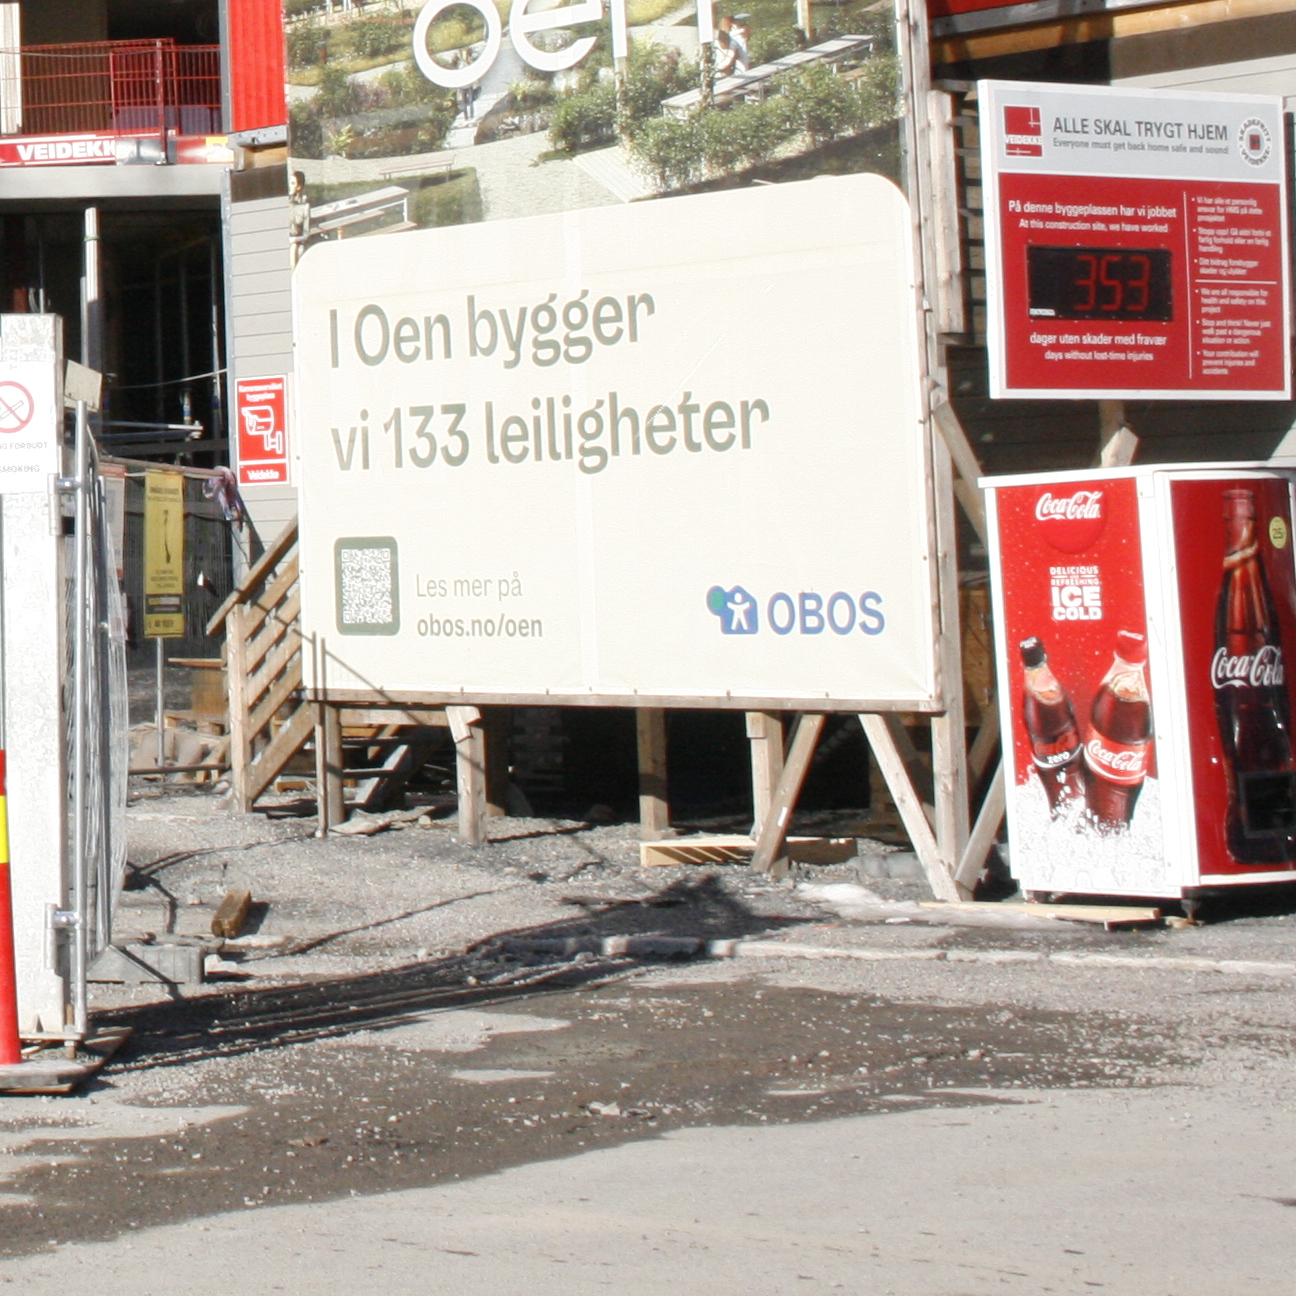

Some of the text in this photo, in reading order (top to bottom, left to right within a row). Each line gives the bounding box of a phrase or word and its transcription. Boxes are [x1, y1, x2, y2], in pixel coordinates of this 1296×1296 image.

[1053, 117, 1229, 141] ALLE SKAL TRYGT HJEM
[1053, 138, 1229, 155] Everyone must get back home safe and sound
[1008, 200, 1177, 219] På denne byggeplassen har vi jobbet
[1030, 218, 1044, 229] this
[1045, 219, 1091, 230] construction
[1109, 222, 1120, 231] we
[1121, 222, 1140, 232] have
[1140, 222, 1168, 233] worked
[1073, 254, 1152, 312] 353
[328, 288, 657, 371] I Oen bygger
[1030, 332, 1167, 346] dager uten skader med fravær
[1044, 350, 1154, 361] days without lost-time injuries
[329, 389, 772, 477] vi 133 leiligheter
[1049, 565, 1099, 576] DELICIOUS
[414, 570, 524, 604] Les mer på
[1050, 585, 1102, 607] ICE
[766, 589, 887, 637] OBOS
[1052, 606, 1102, 621] COLD
[416, 612, 545, 641] obos.no/oen
[1210, 644, 1285, 690] Coca-Cola
